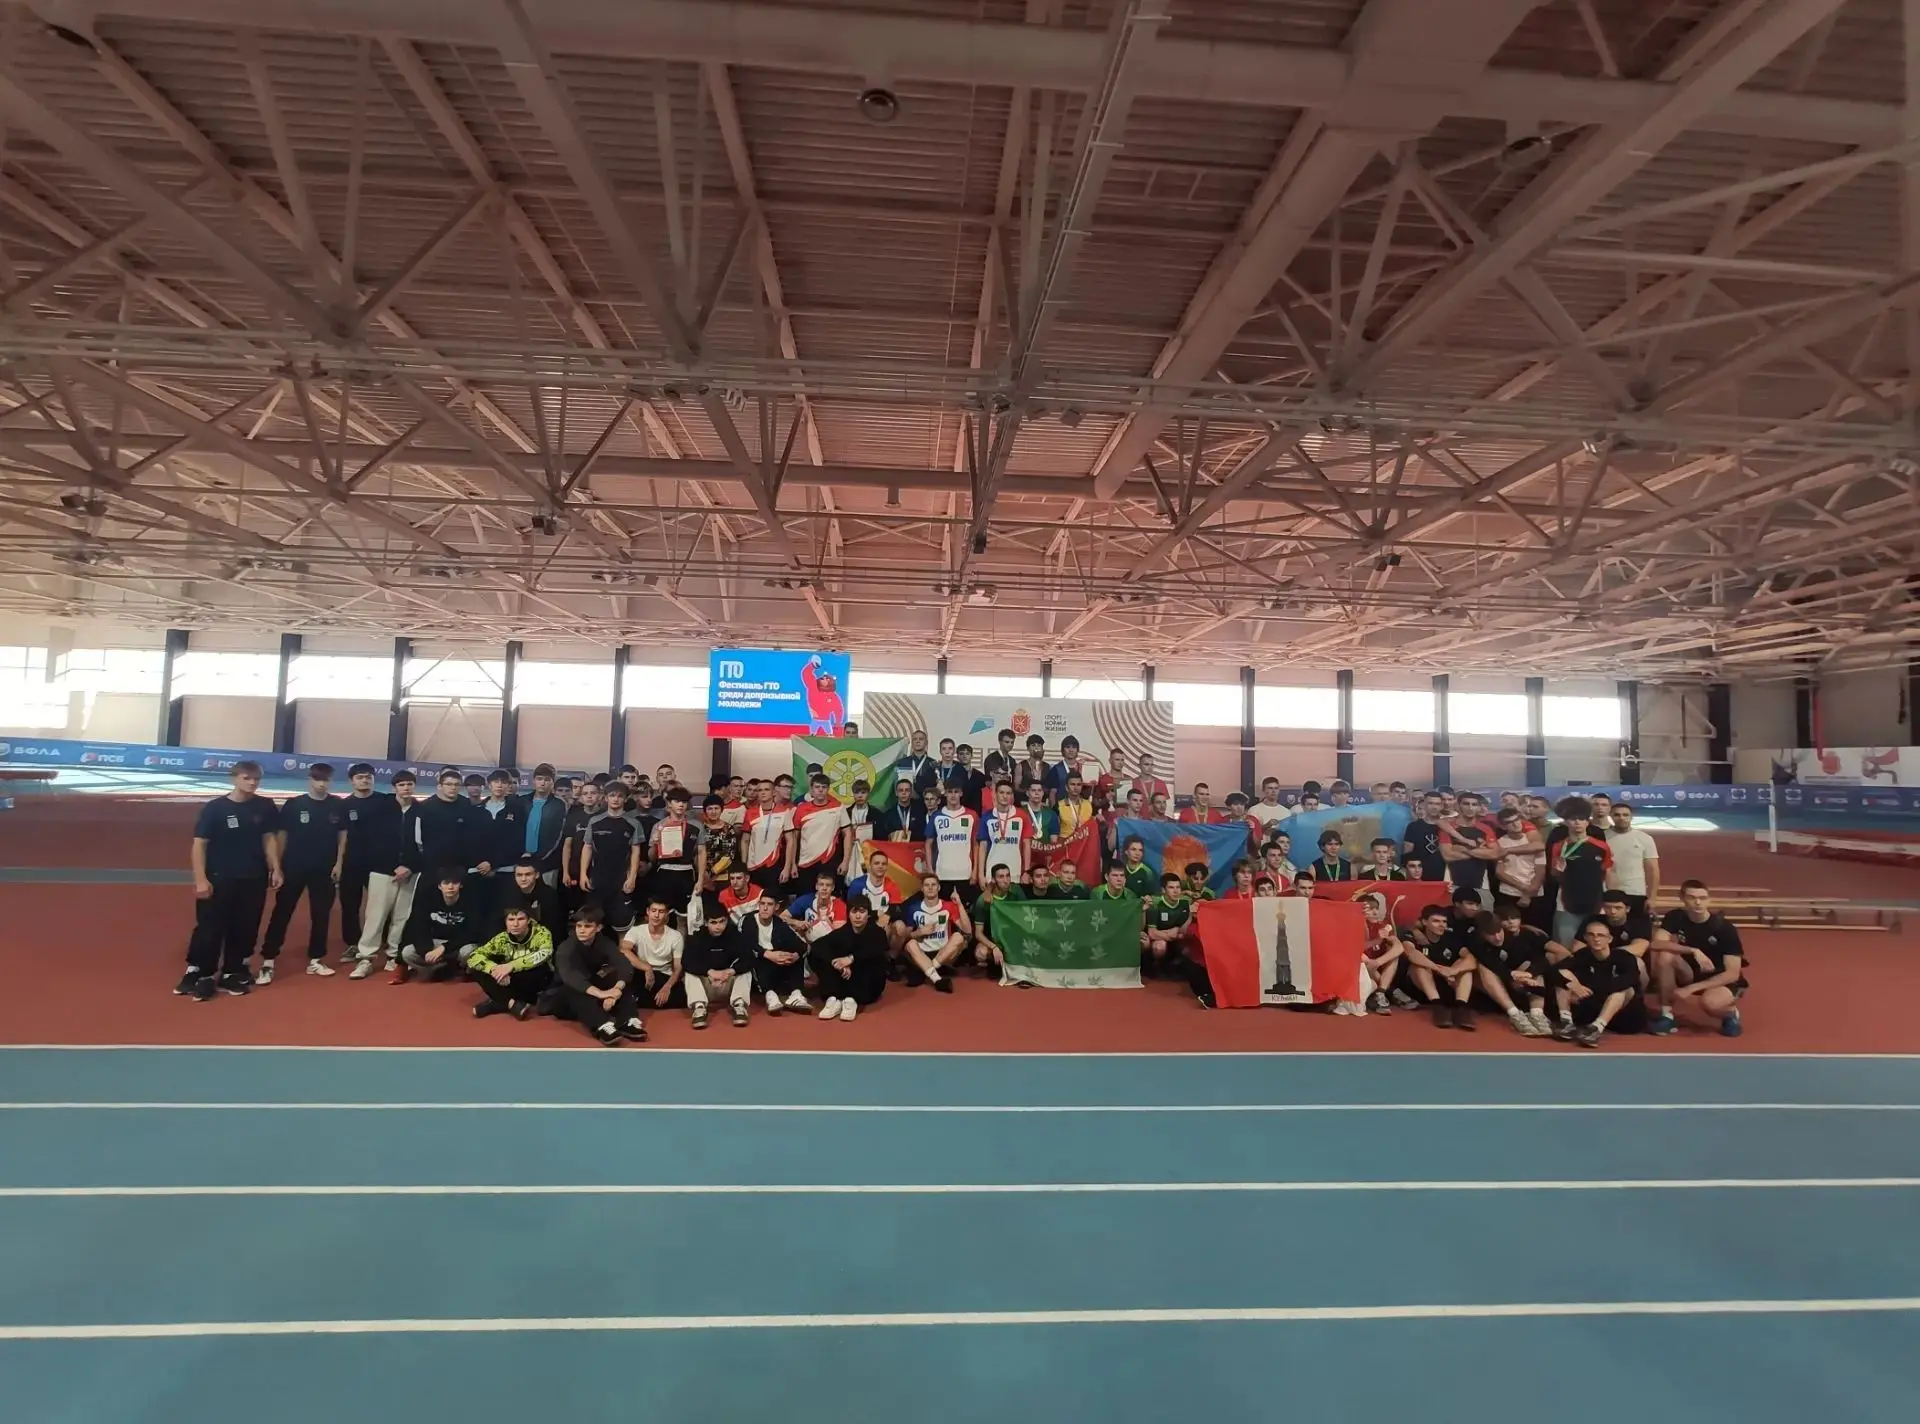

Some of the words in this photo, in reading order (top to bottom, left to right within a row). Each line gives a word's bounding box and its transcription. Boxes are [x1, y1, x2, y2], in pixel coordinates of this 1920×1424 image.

[720, 661, 744, 679] ГТО
[719, 681, 763, 689] Фестиваль
[764, 682, 780, 690] ГТО
[718, 691, 744, 700] среди
[744, 692, 801, 701] допризывной
[14, 746, 61, 756] ВФЛА
[98, 755, 125, 763] ПСБ
[160, 757, 185, 766] ПСБ
[217, 760, 237, 768] ПС
[937, 818, 950, 829] 20
